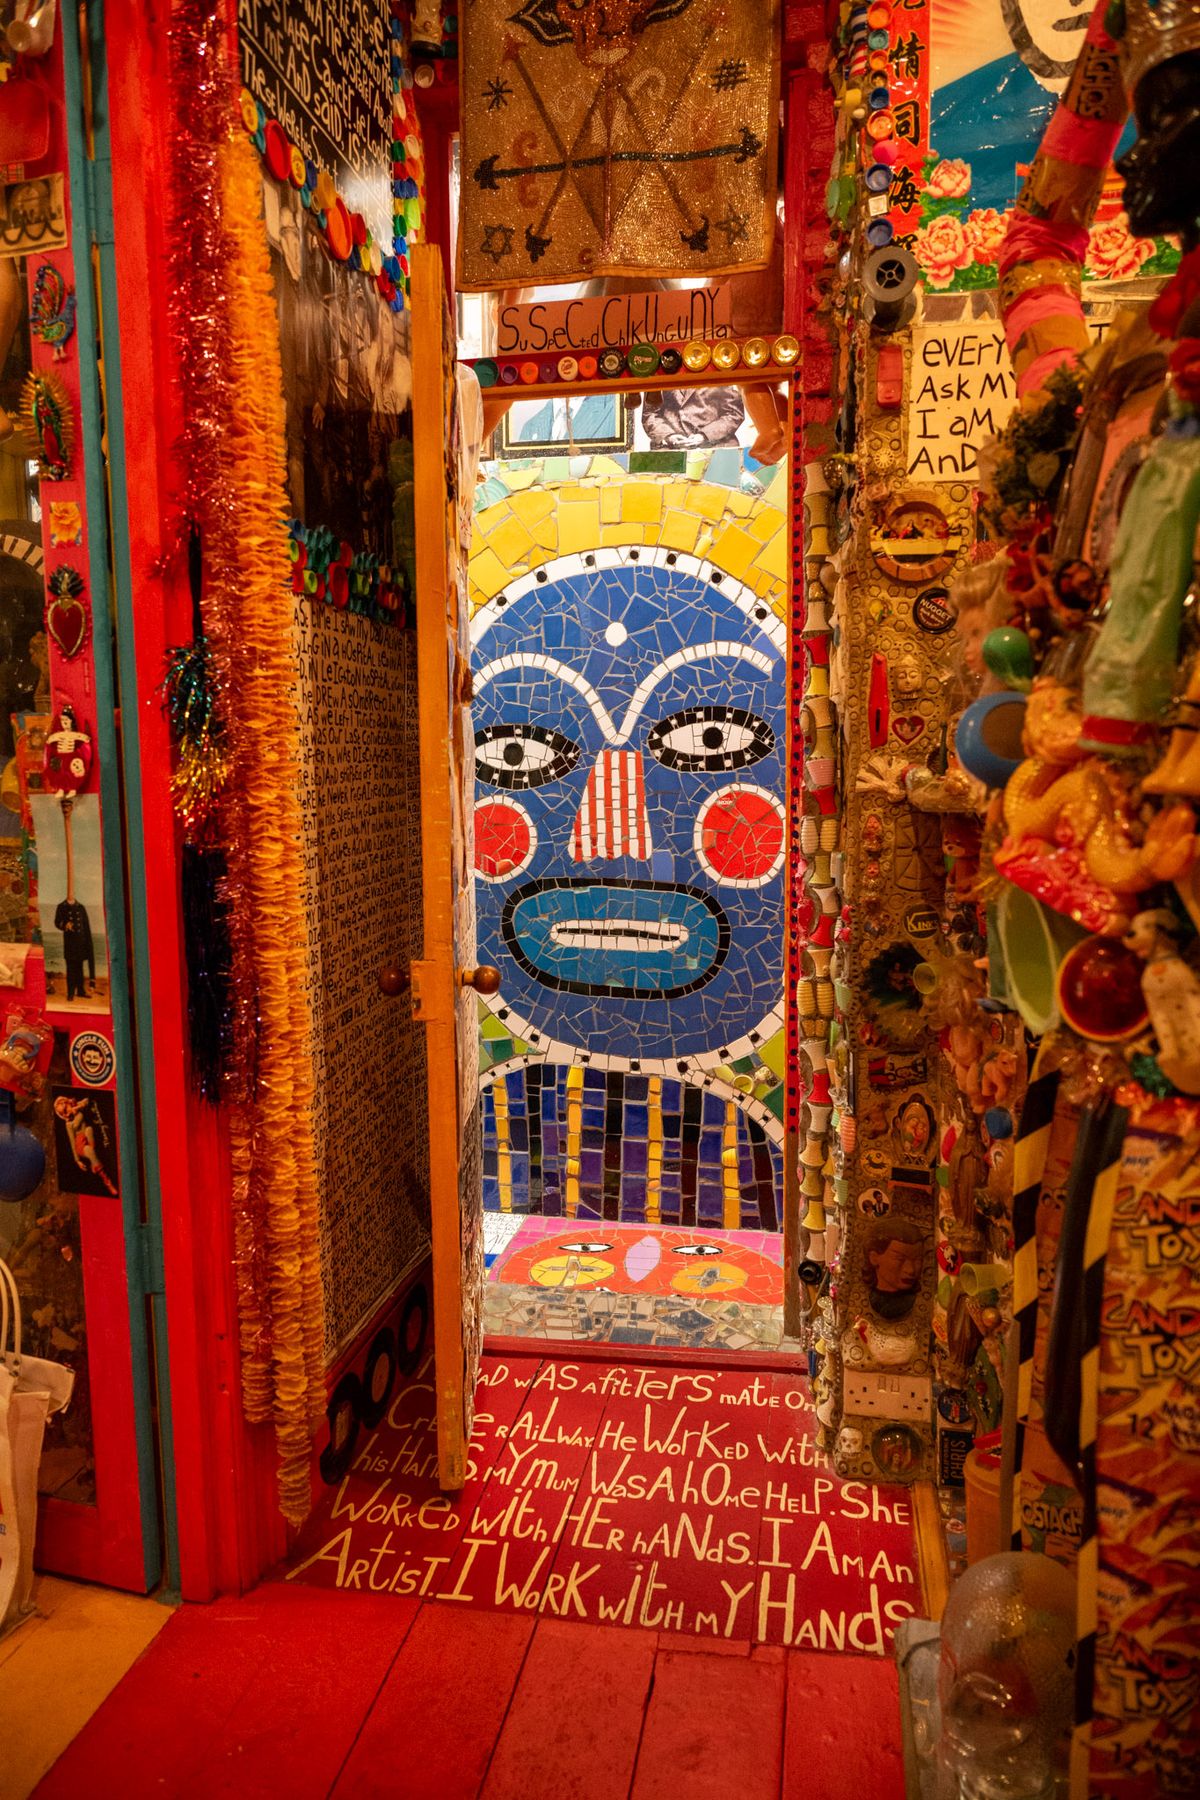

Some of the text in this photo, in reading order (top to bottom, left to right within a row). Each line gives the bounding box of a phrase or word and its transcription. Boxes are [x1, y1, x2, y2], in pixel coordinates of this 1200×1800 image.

[916, 375, 971, 403] Ask
[917, 408, 940, 438] I
[919, 598, 953, 621] NUGGET
[75, 1035, 111, 1054] UNCLE FUN
[474, 1363, 509, 1387] AD
[950, 1440, 967, 1479] CHRIS
[646, 1466, 675, 1502] A
[758, 1516, 794, 1568] I
[869, 1550, 914, 1584] An
[436, 1538, 497, 1601] I
